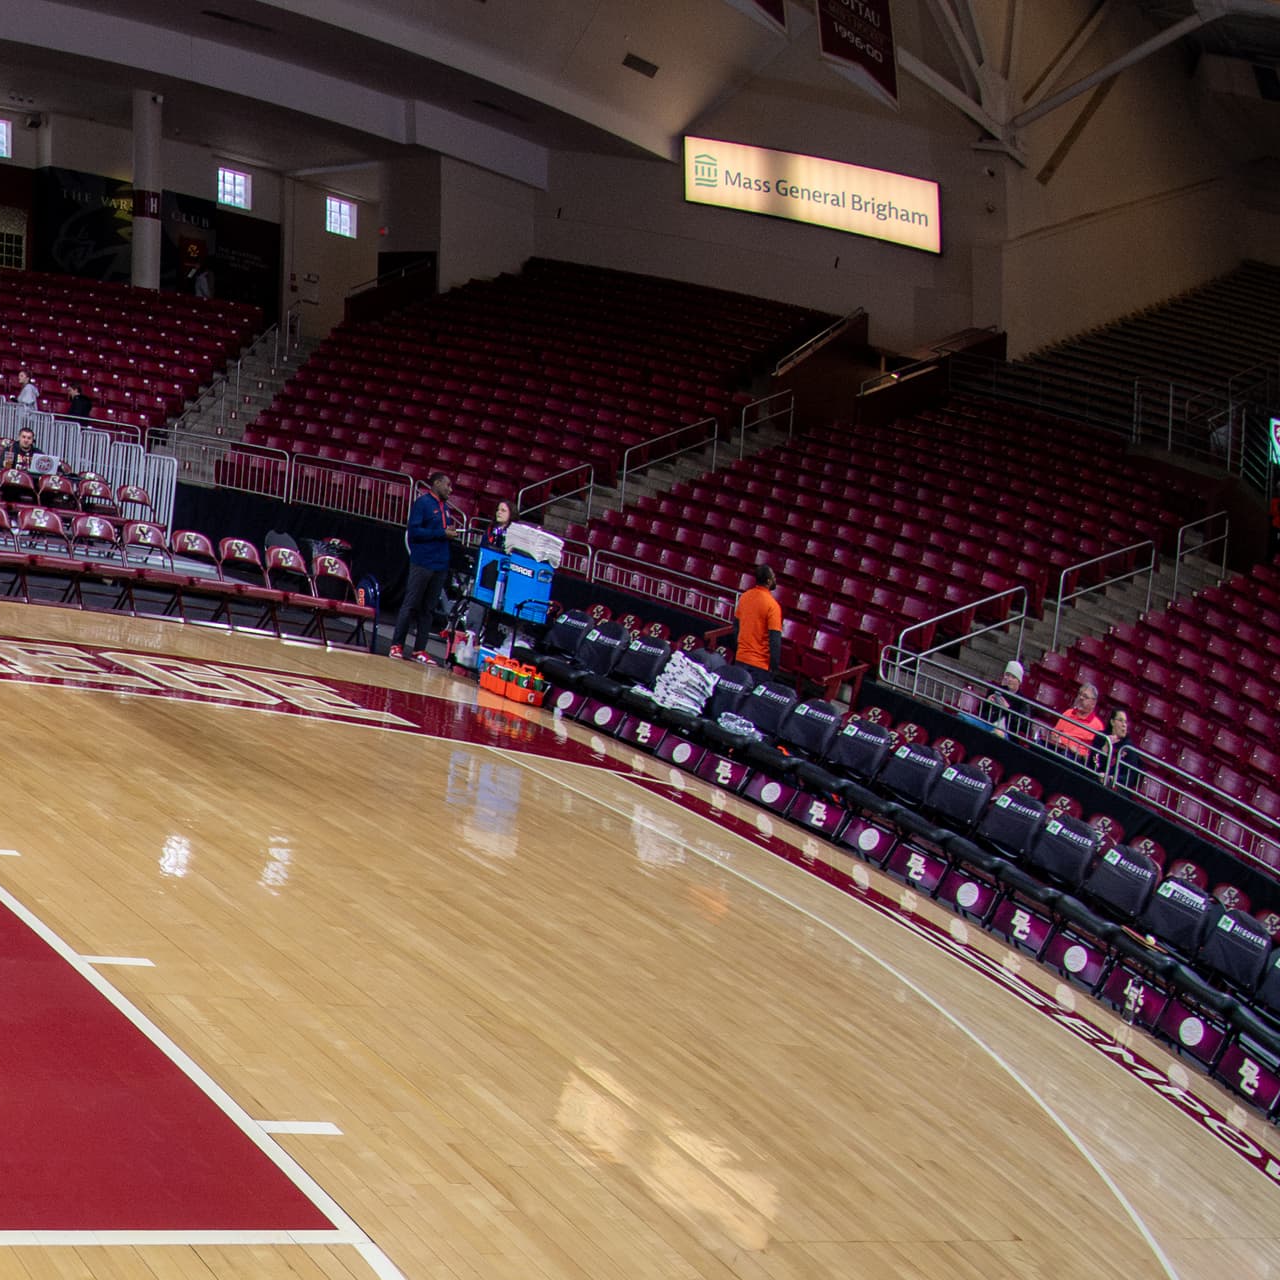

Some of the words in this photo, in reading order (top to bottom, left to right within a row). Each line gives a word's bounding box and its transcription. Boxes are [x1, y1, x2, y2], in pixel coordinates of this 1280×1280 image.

[724, 169, 771, 193] Mass
[775, 179, 846, 208] General
[850, 194, 929, 227] Brigham
[906, 853, 927, 881] BC
[1010, 908, 1032, 941] BC
[1238, 1057, 1260, 1096] BC
